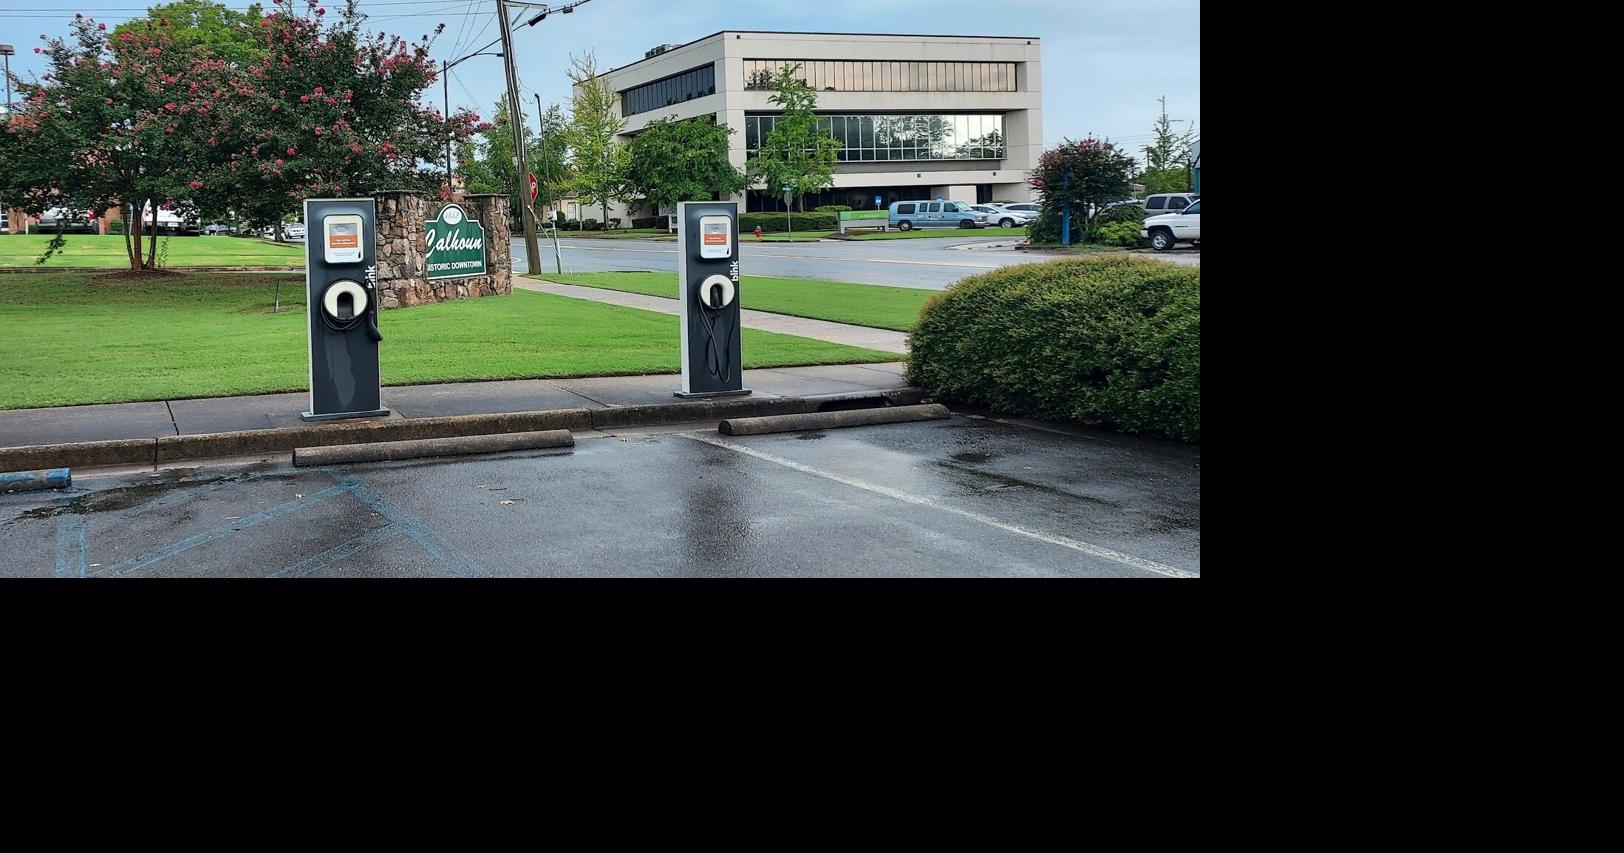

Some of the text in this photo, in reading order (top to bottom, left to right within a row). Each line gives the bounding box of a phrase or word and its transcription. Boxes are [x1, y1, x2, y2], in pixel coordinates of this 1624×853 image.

[425, 228, 483, 258] Calhoun
[426, 260, 482, 272] ISTORIC DOWNTOWN
[730, 261, 738, 282] blink
